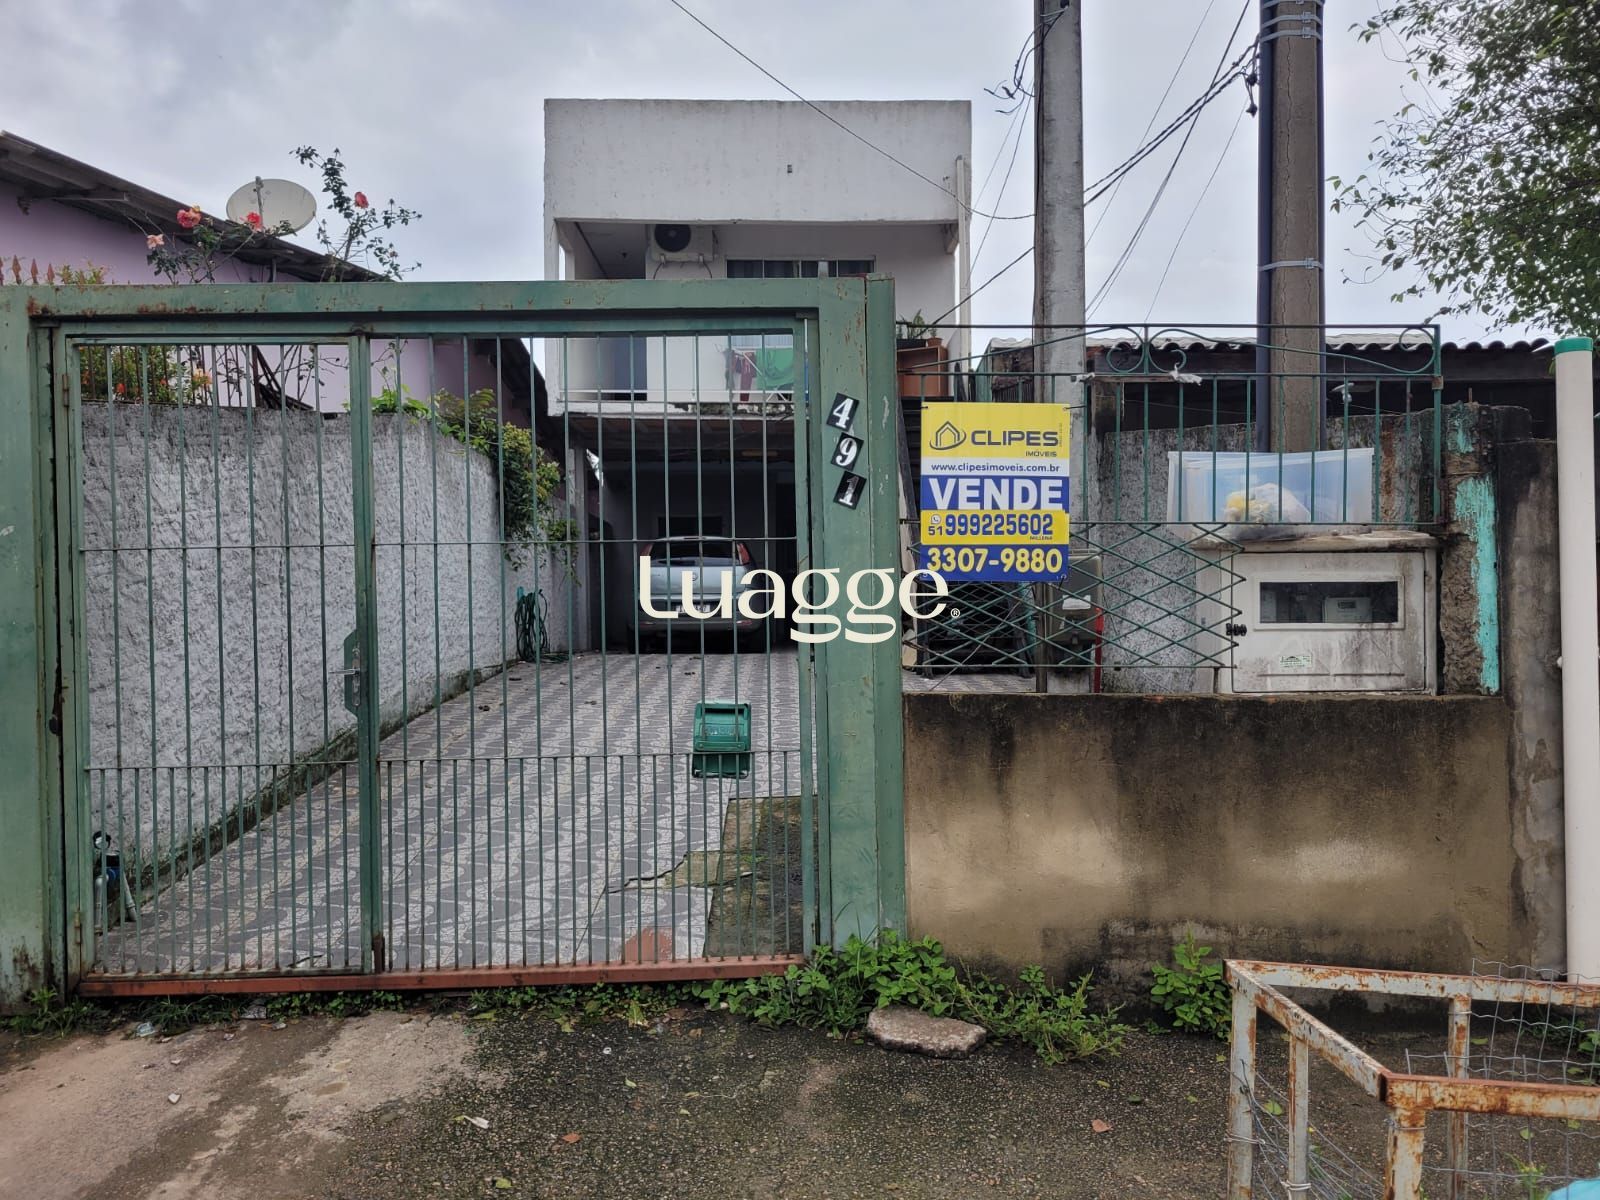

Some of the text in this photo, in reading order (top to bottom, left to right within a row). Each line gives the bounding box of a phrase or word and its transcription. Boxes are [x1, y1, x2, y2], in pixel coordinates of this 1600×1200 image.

[971, 430, 1059, 446] CLIPES
[832, 398, 862, 507] 491
[1025, 449, 1057, 457] IMÓVEIS
[931, 462, 1060, 473] www.clipesimoveis.com.br
[928, 478, 1063, 510] VENDE
[928, 513, 1053, 536] 51 999225602
[927, 547, 1063, 573] 3307-9880
